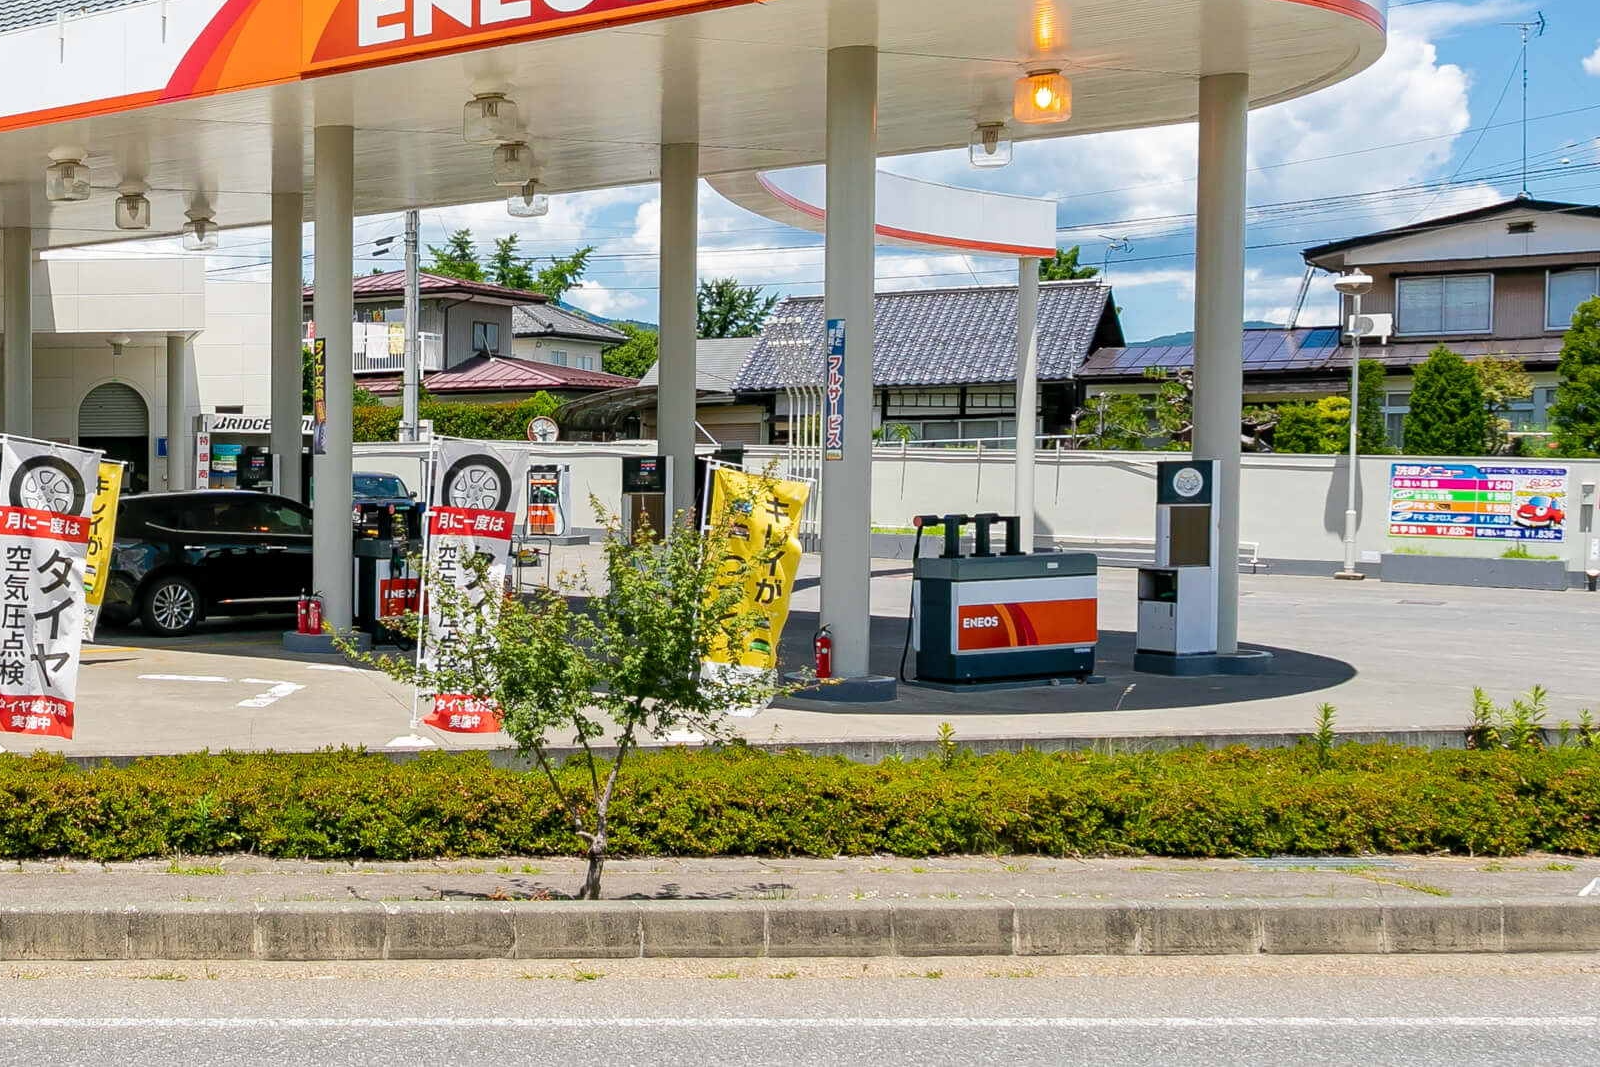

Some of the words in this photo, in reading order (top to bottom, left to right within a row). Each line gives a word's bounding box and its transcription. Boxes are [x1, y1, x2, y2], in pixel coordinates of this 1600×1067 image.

[827, 355, 843, 448] フルサービス
[4, 511, 81, 536] 月に一度は
[437, 513, 505, 533] 月に一度は
[30, 548, 75, 688] タイヤ
[963, 616, 999, 629] ENEOS
[11, 715, 51, 730] 実施中
[448, 714, 481, 729] 実施中
